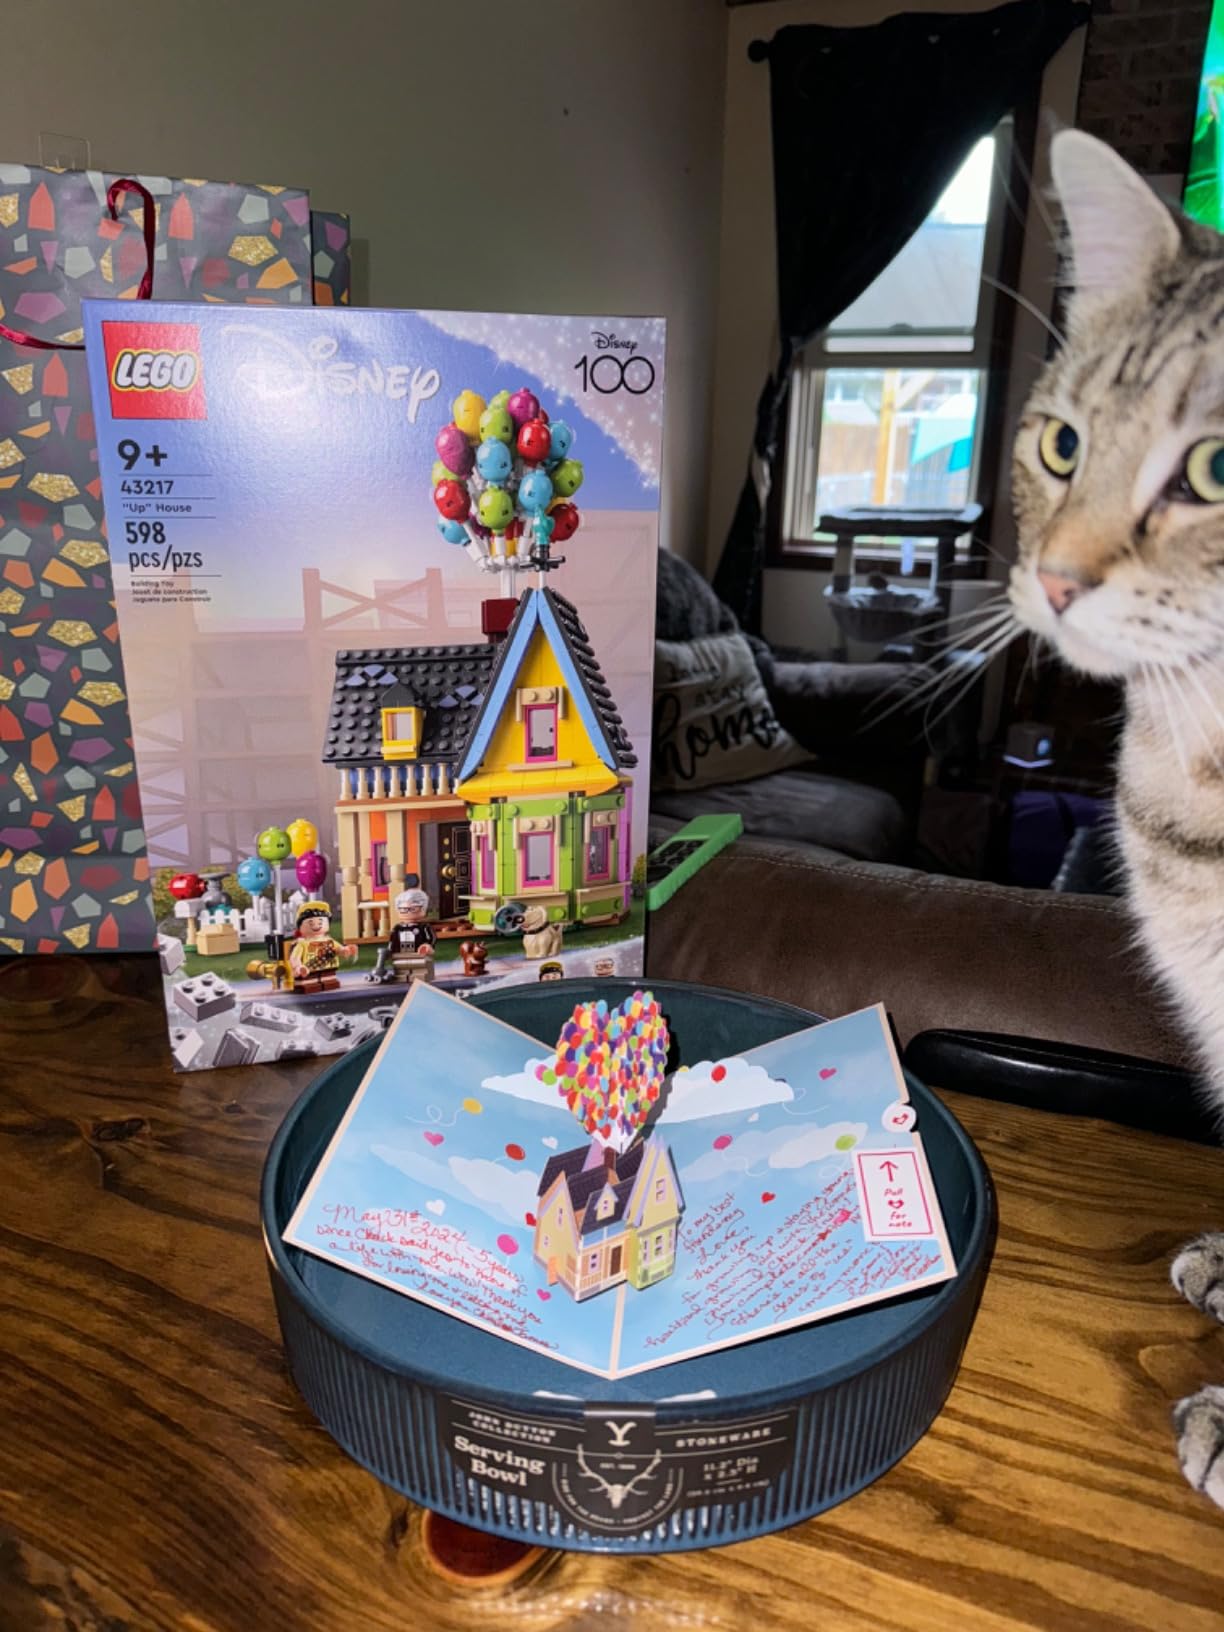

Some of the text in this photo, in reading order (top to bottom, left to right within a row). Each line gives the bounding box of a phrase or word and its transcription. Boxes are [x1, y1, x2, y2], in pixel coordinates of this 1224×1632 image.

[591, 332, 638, 355] Disney
[114, 352, 196, 389] LEGO
[574, 354, 655, 395] 100
[117, 439, 168, 471] 9+
[121, 480, 174, 495] 43217
[122, 503, 192, 514] "Up" House
[125, 521, 166, 544] 598
[128, 544, 204, 573] pcs/pzs
[653, 692, 779, 780] home
[884, 1188, 903, 1197] Pull
[322, 1204, 382, 1233] May
[890, 1211, 906, 1220] for
[605, 1421, 637, 1446] Y
[676, 1427, 771, 1448] STONEWARE
[454, 1435, 546, 1475] Serving
[471, 1458, 527, 1487] Bowl
